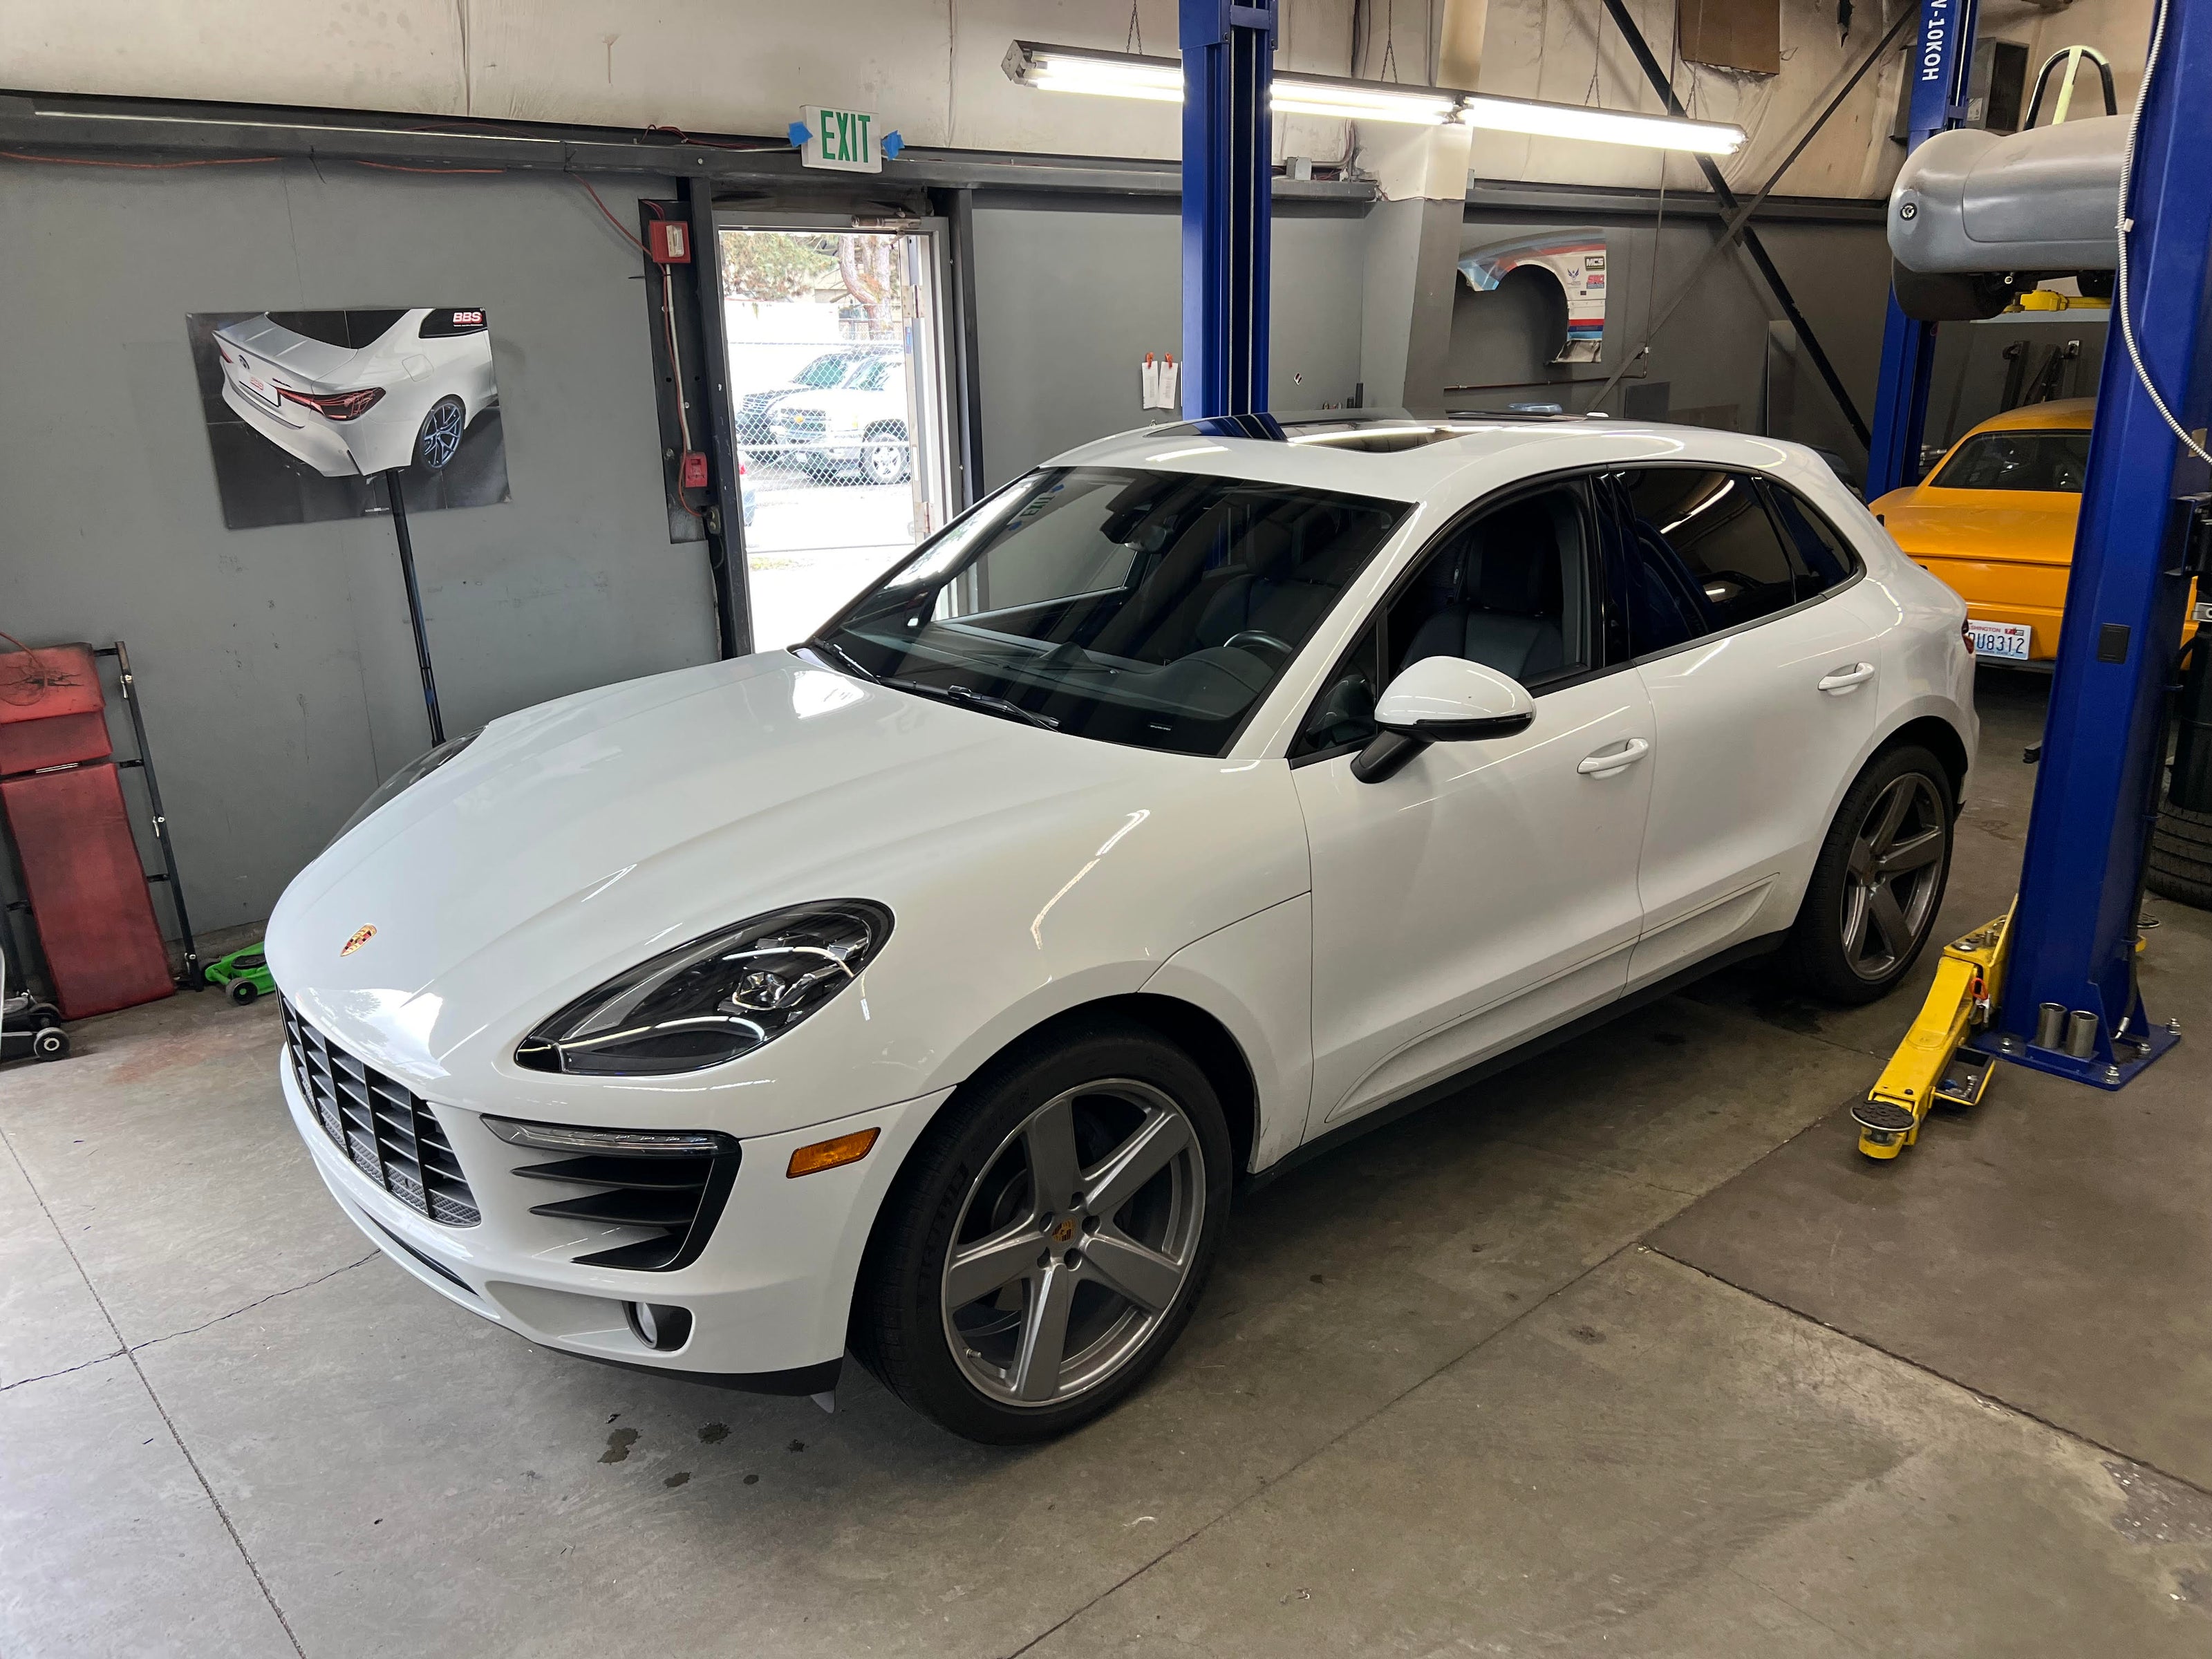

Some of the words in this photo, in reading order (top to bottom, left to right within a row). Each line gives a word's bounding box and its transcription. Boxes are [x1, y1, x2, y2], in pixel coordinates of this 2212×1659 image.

[820, 110, 871, 163] EXIT
[1586, 258, 1604, 267] MCS
[453, 311, 482, 324] BBS
[1969, 625, 2001, 633] SHINGTON
